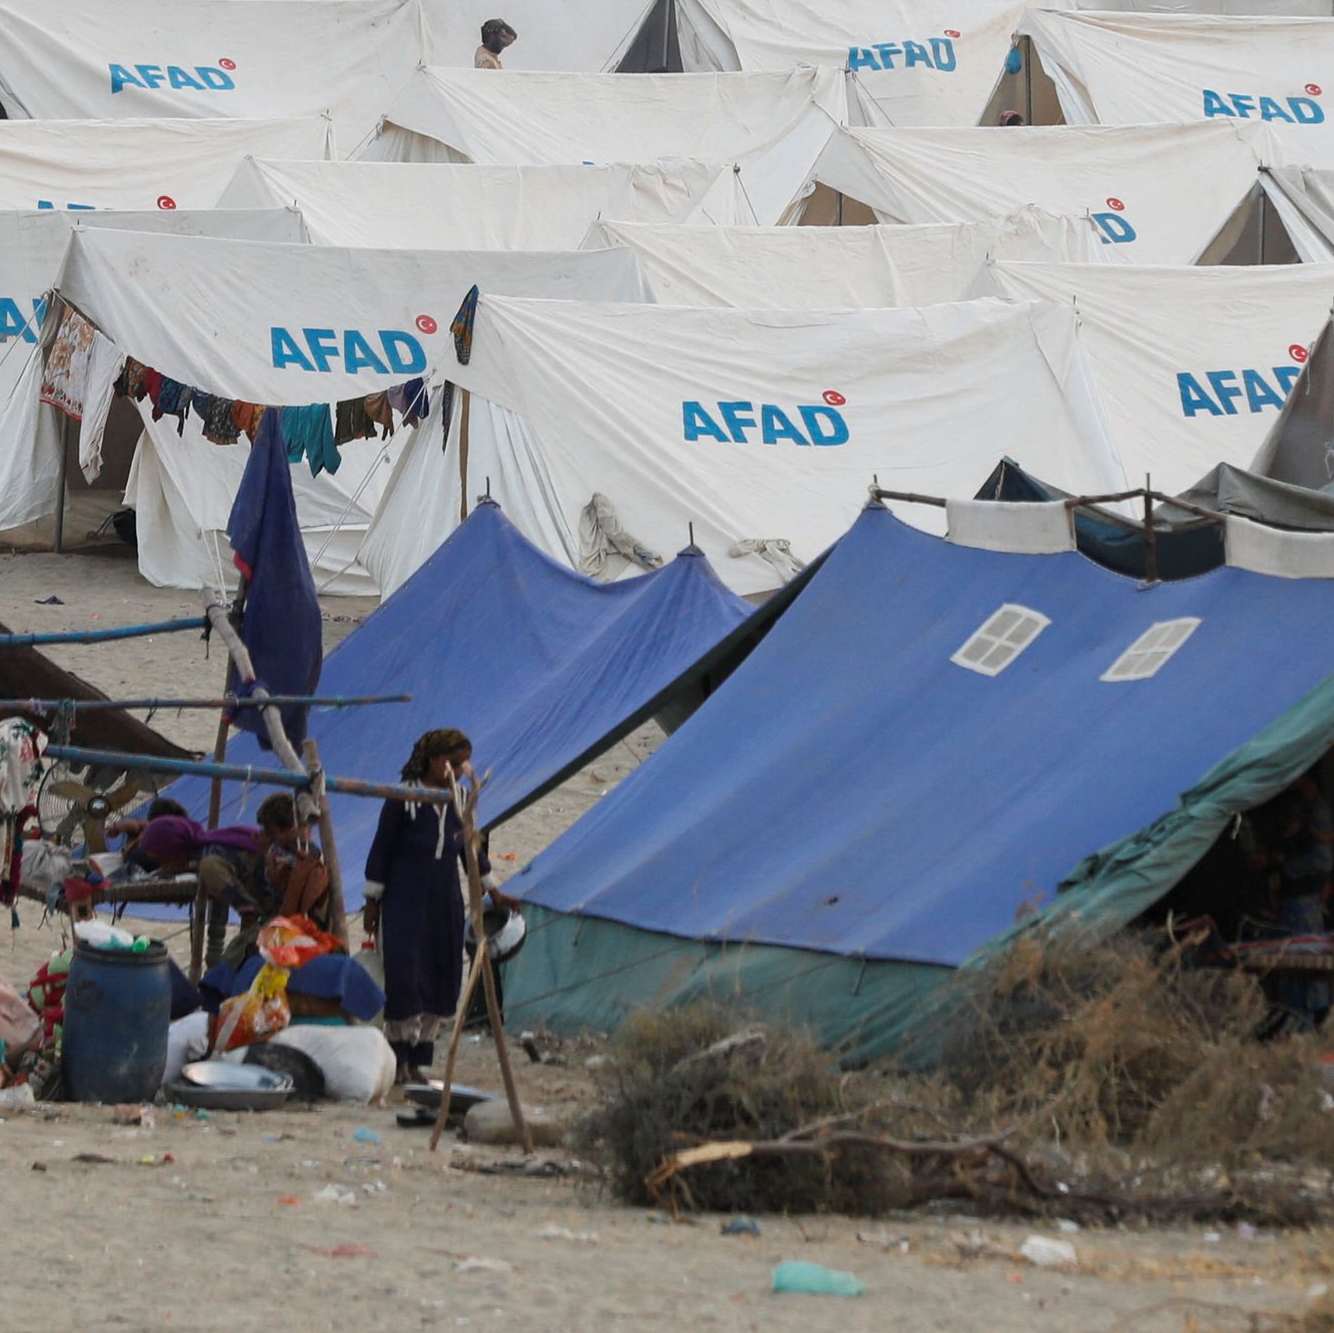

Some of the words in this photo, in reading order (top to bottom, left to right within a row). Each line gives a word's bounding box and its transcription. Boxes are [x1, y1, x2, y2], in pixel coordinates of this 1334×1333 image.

[848, 38, 956, 72] AFAD
[109, 64, 235, 94] AFAD
[1202, 89, 1325, 124] AFAD
[270, 327, 427, 375] AFAD
[682, 401, 850, 446] AFAD
